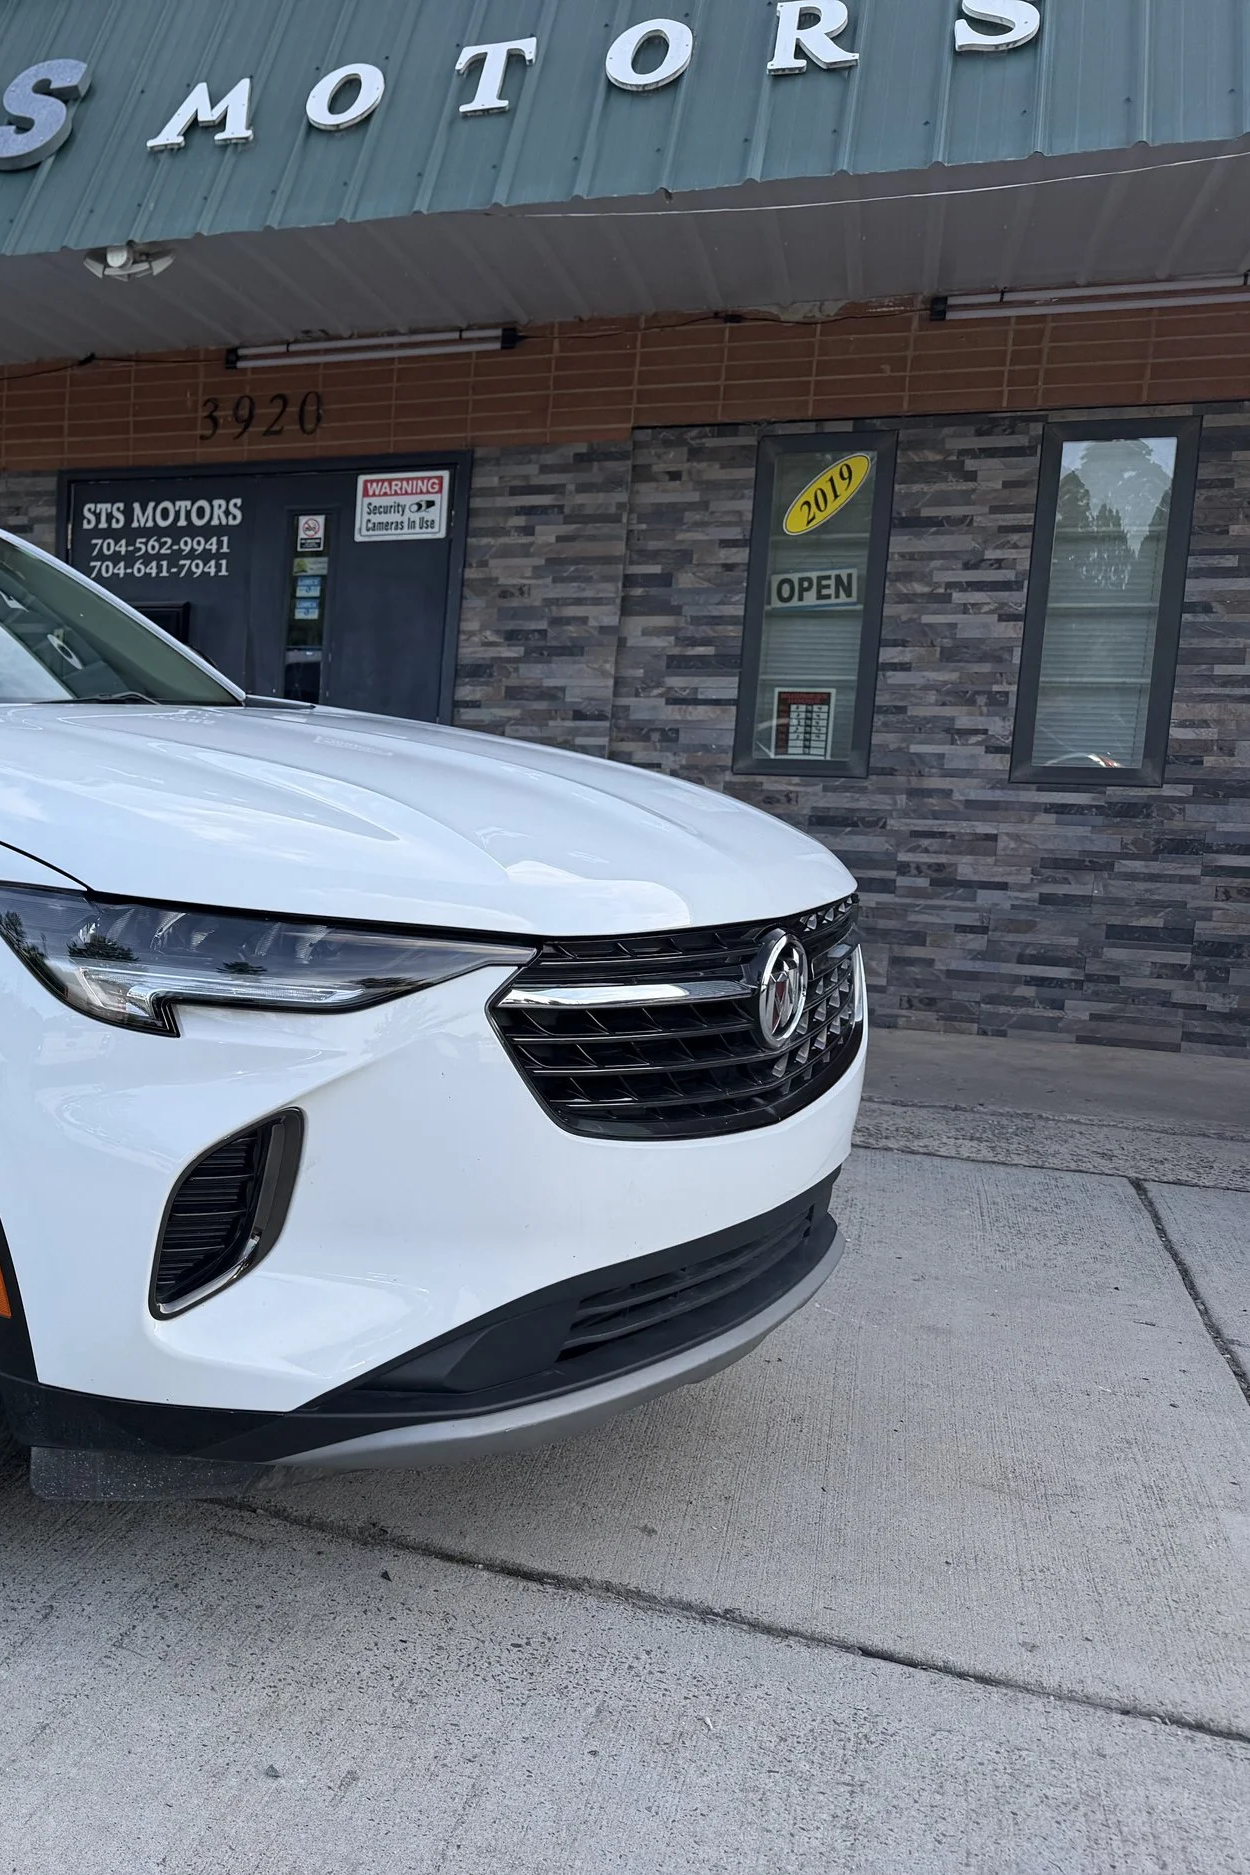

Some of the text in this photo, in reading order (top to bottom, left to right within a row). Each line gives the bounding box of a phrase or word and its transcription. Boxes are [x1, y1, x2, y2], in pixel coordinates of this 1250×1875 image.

[146, 0, 1041, 150] MOTORS
[199, 391, 324, 441] 3920
[366, 479, 440, 496] WARNING
[800, 463, 853, 526] 2019
[82, 498, 243, 530] STS MOTORS
[366, 501, 407, 516] Security
[365, 516, 436, 532] Cameras In Use
[91, 536, 230, 556] 704-562-9941
[89, 559, 229, 579] 704-641-7941
[776, 572, 853, 604] OPEN
